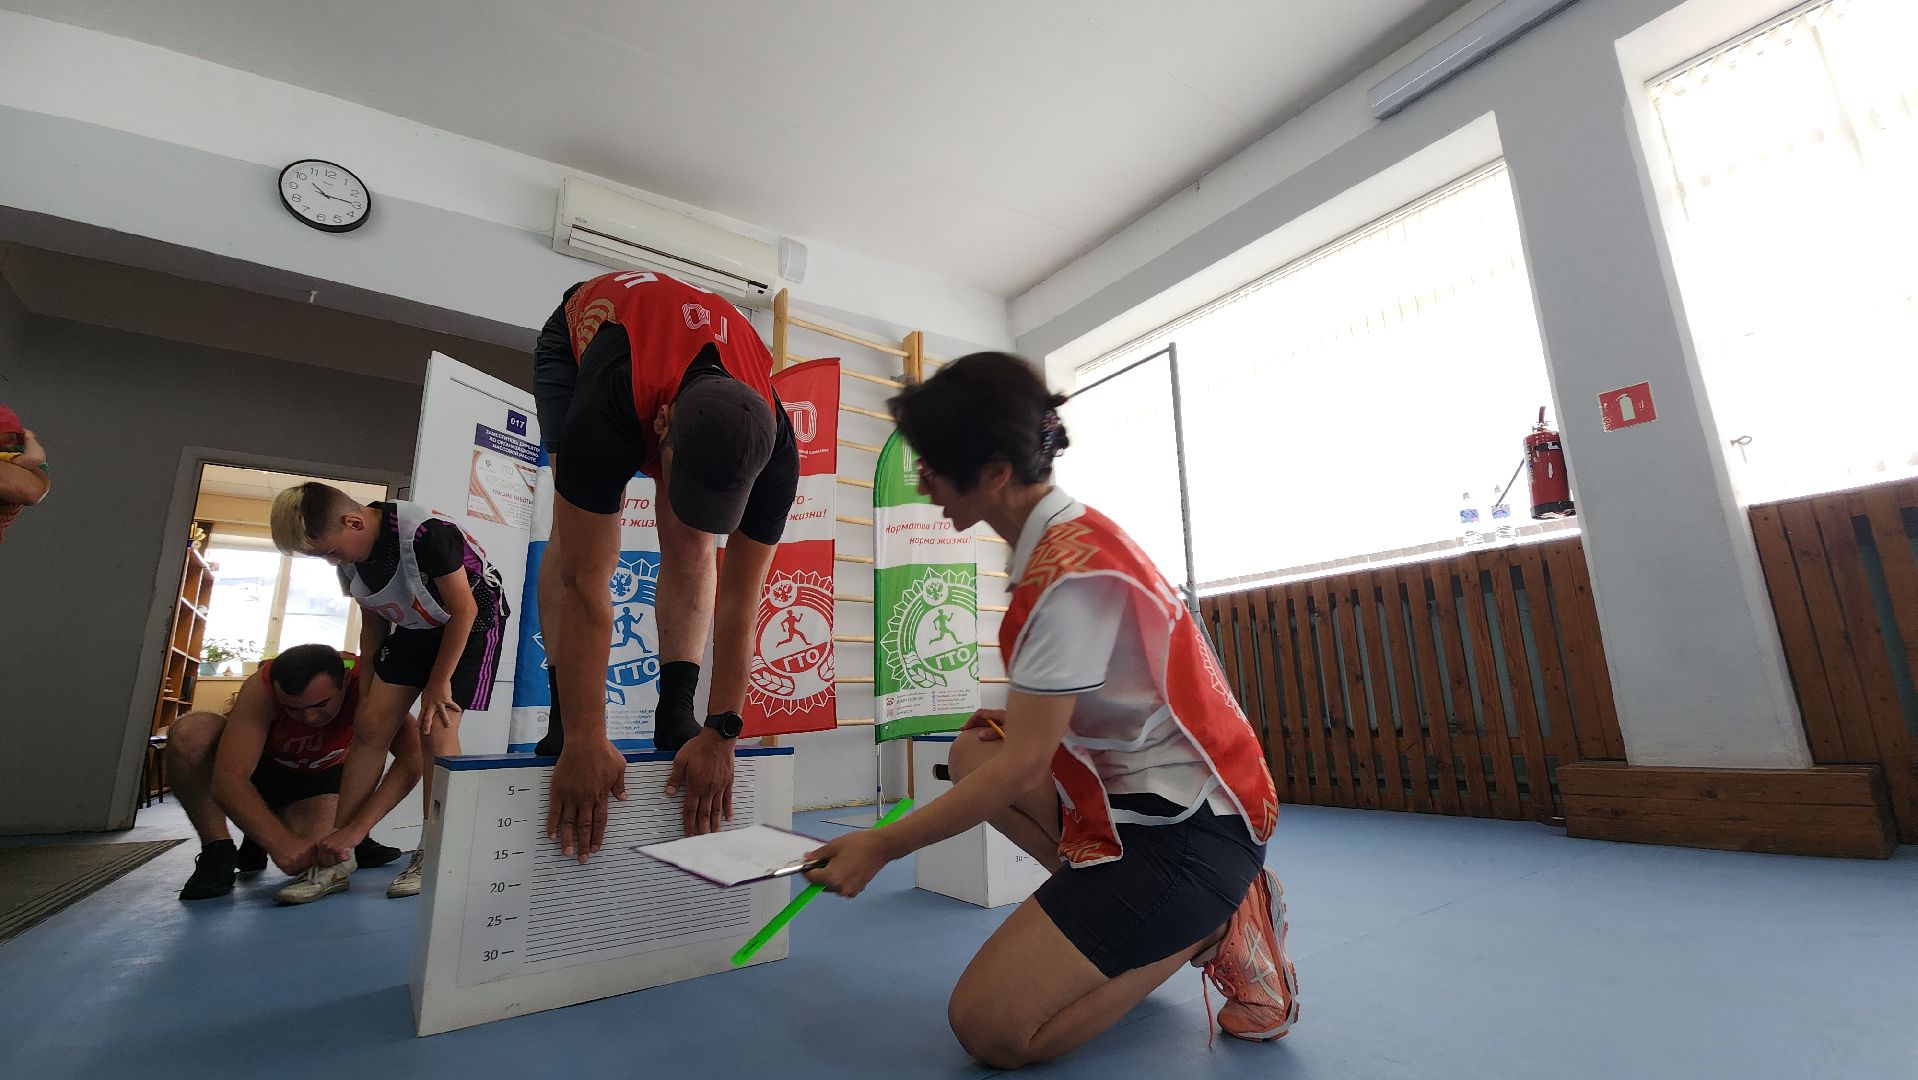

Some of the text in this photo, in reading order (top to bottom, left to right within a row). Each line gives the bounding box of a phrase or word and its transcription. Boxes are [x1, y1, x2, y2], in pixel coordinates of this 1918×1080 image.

[295, 171, 307, 181] 10
[324, 169, 337, 179] 12
[289, 181, 298, 189] 9
[291, 193, 301, 202] 8
[350, 189, 359, 198] 2
[351, 201, 361, 209] 3
[316, 213, 326, 221] 6
[333, 214, 342, 223] 5
[346, 210, 355, 218] 4
[510, 417, 525, 429] 017
[624, 498, 650, 510] ГТО
[789, 508, 827, 520] жизни!
[629, 518, 657, 528] жиз
[933, 521, 951, 531] ГТО
[909, 535, 972, 547] норма жизни!
[782, 647, 820, 673] ГТО
[935, 647, 971, 670] ГТО
[613, 657, 661, 684] ГТО
[507, 785, 515, 796] 5
[497, 817, 512, 828] 10
[494, 849, 509, 860] 15
[490, 881, 505, 893] 20
[486, 915, 502, 928] 25
[482, 949, 499, 962] 30
